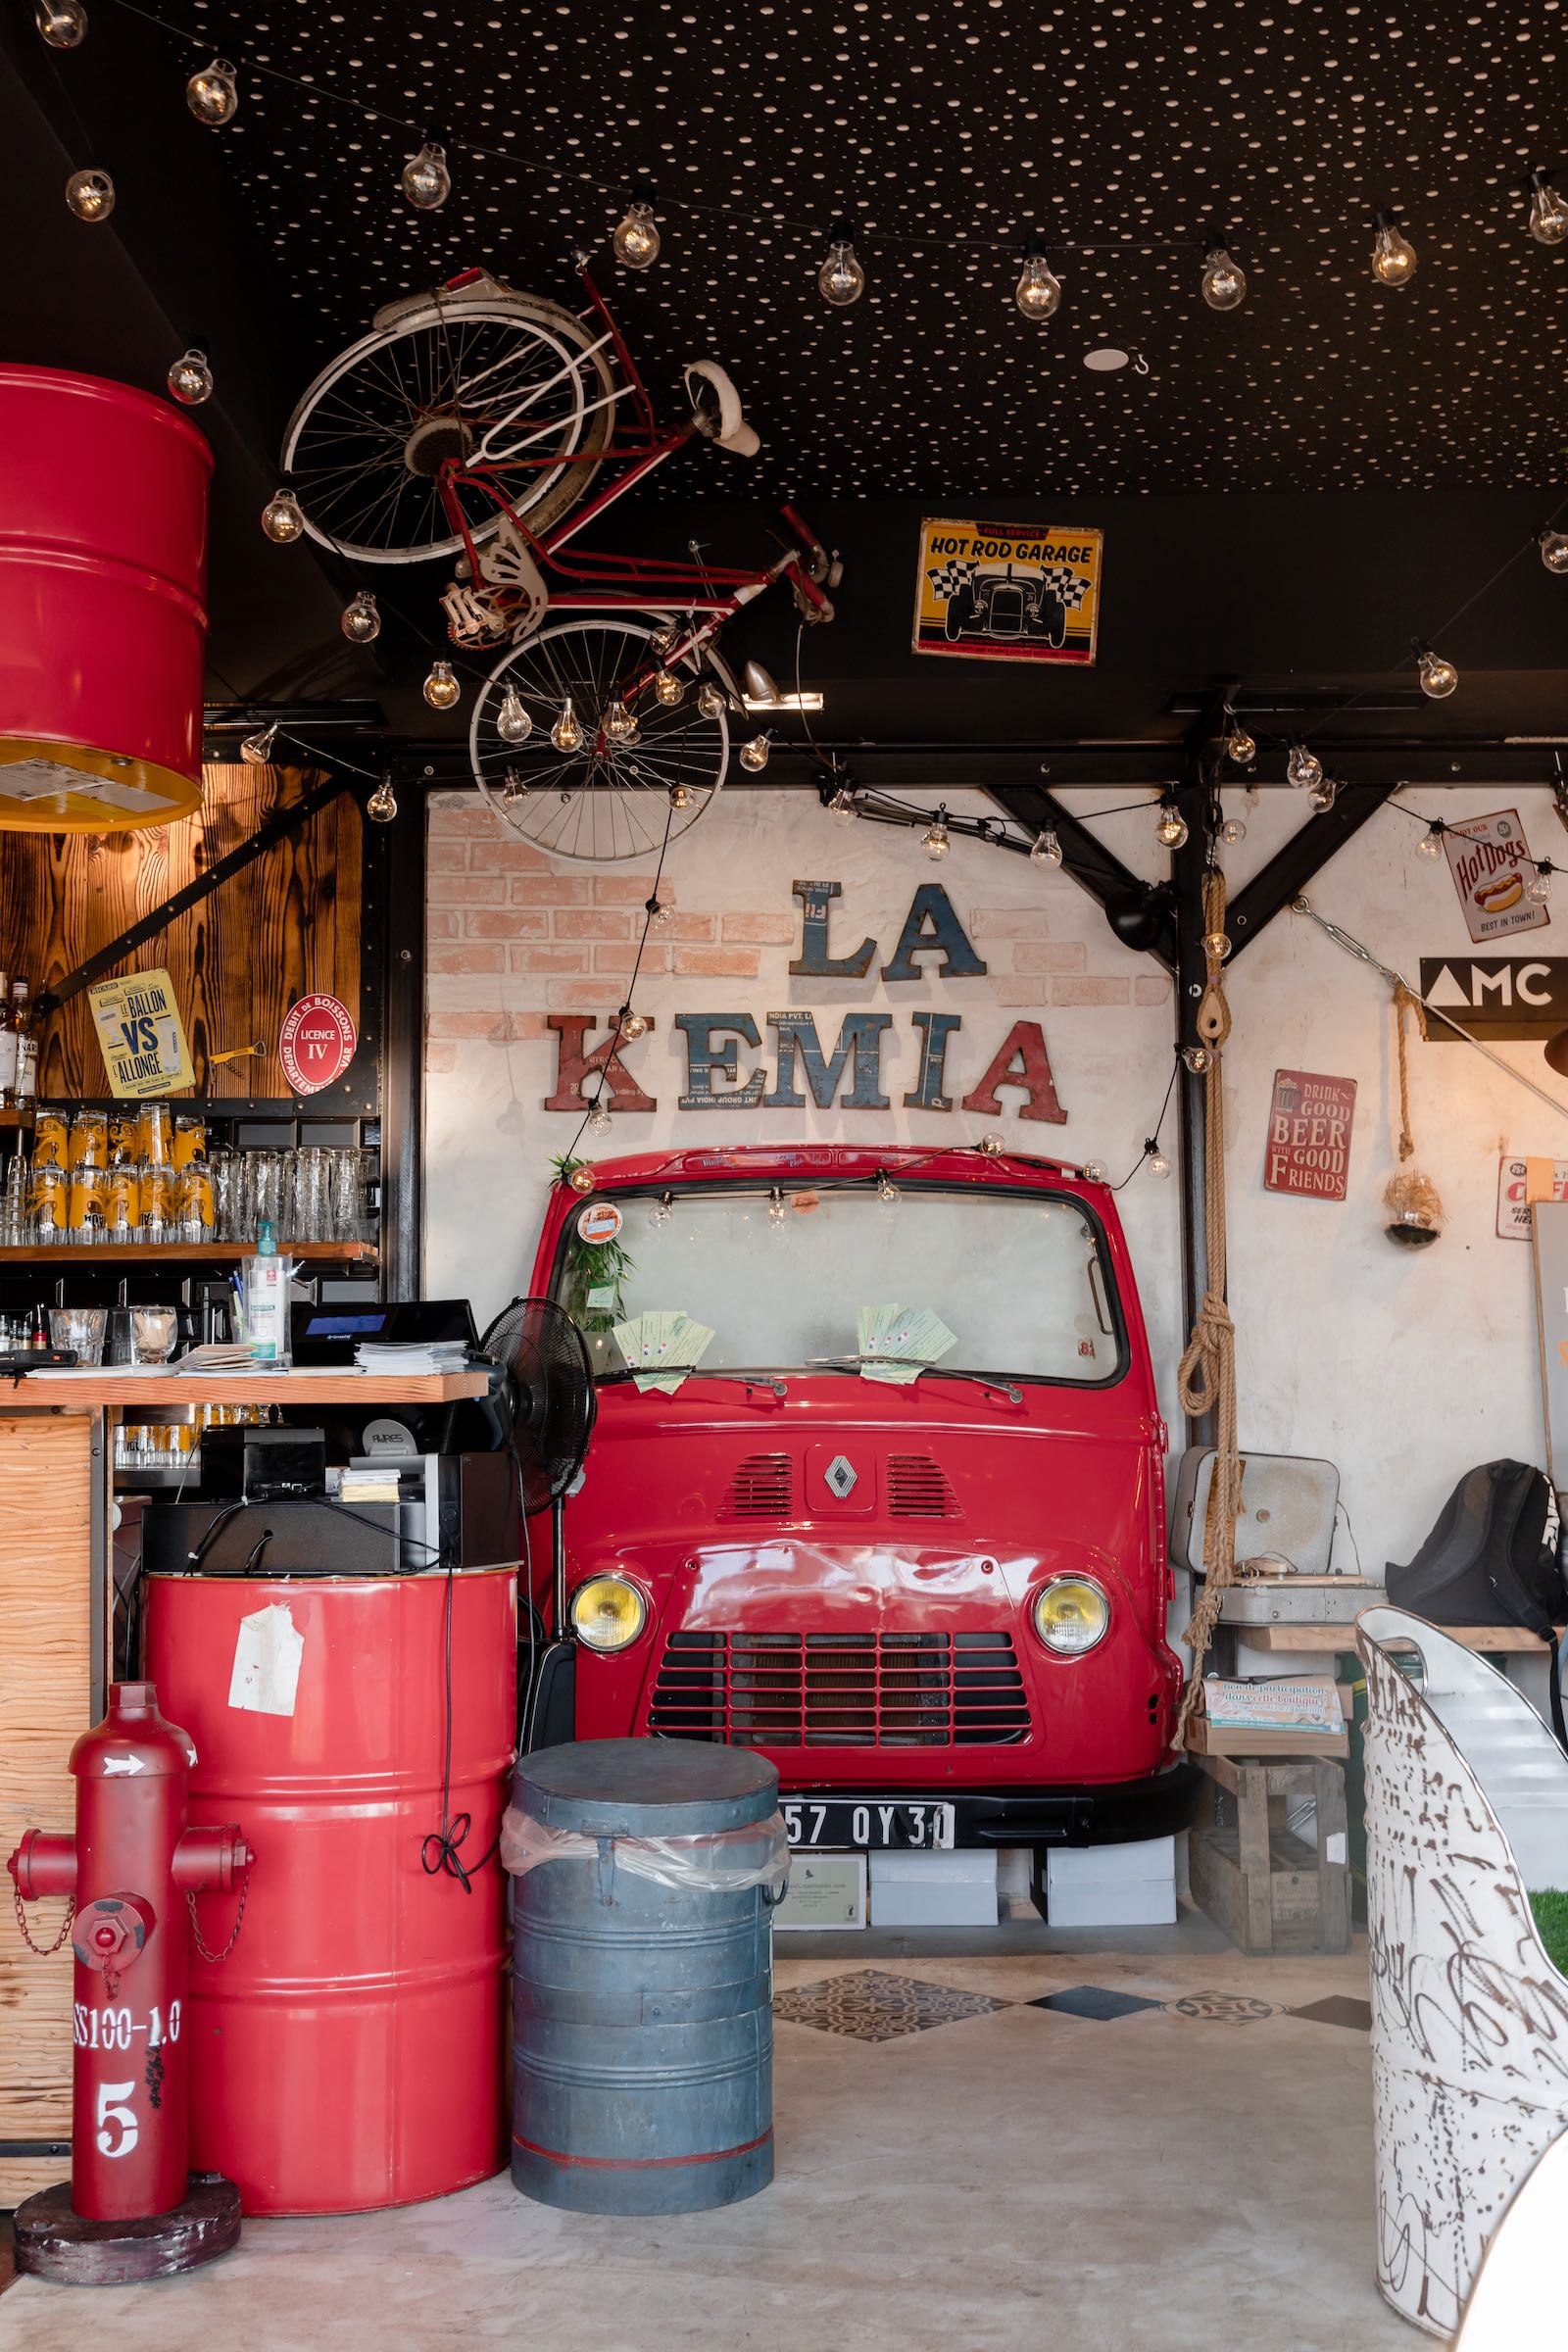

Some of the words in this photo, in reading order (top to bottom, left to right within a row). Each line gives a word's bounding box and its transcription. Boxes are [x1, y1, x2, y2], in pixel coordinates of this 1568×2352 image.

[930, 537, 969, 556] HOT
[971, 540, 1012, 559] ROD
[1015, 543, 1094, 564] GARAGE
[789, 879, 988, 982] LA
[1481, 920, 1498, 933] BEST
[1500, 917, 1508, 927] IN
[1510, 910, 1536, 924] TOWN!
[1422, 962, 1553, 1006] AMC
[126, 988, 168, 1019] BALLON
[283, 1009, 302, 1041] DEBIT
[300, 1002, 313, 1011] DE
[314, 997, 353, 1042] BOISSONS
[121, 1016, 159, 1055] VS
[300, 1029, 336, 1041] LICENCE
[307, 1043, 329, 1059] IV
[544, 1011, 1068, 1125] KEMIA
[1303, 1083, 1342, 1102] DRINK
[1300, 1100, 1351, 1122] GOOD
[1272, 1114, 1347, 1151] BEER
[1270, 1153, 1345, 1194] FRIENDS
[1271, 1144, 1292, 1155] WITH
[1293, 1149, 1345, 1174] GOOD
[1225, 1691, 1251, 1702] dans
[1258, 1684, 1325, 1695] participation
[96, 2080, 139, 2158] 5
